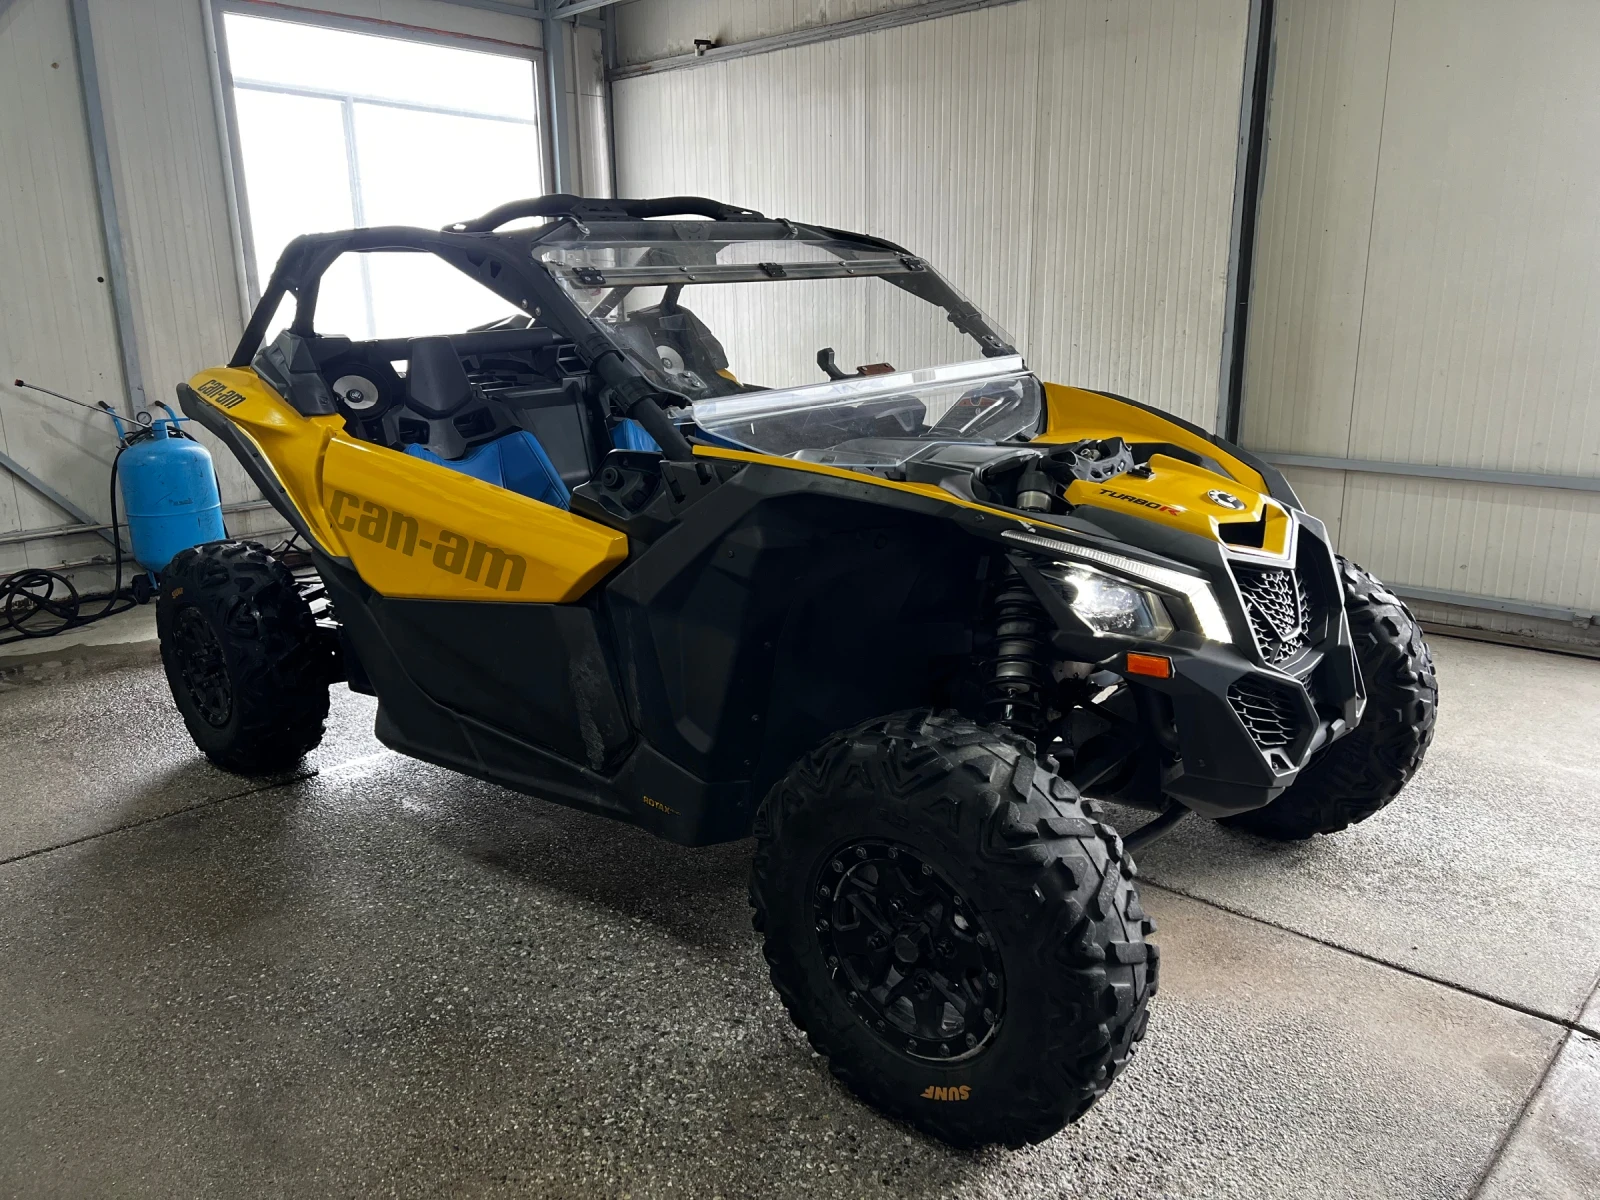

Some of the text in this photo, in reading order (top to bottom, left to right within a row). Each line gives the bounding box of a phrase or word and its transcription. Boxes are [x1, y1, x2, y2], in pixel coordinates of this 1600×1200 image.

[198, 379, 247, 410] can-am
[329, 489, 527, 592] can-am
[643, 795, 670, 815] ROTAX
[920, 1084, 972, 1101] SUNF
